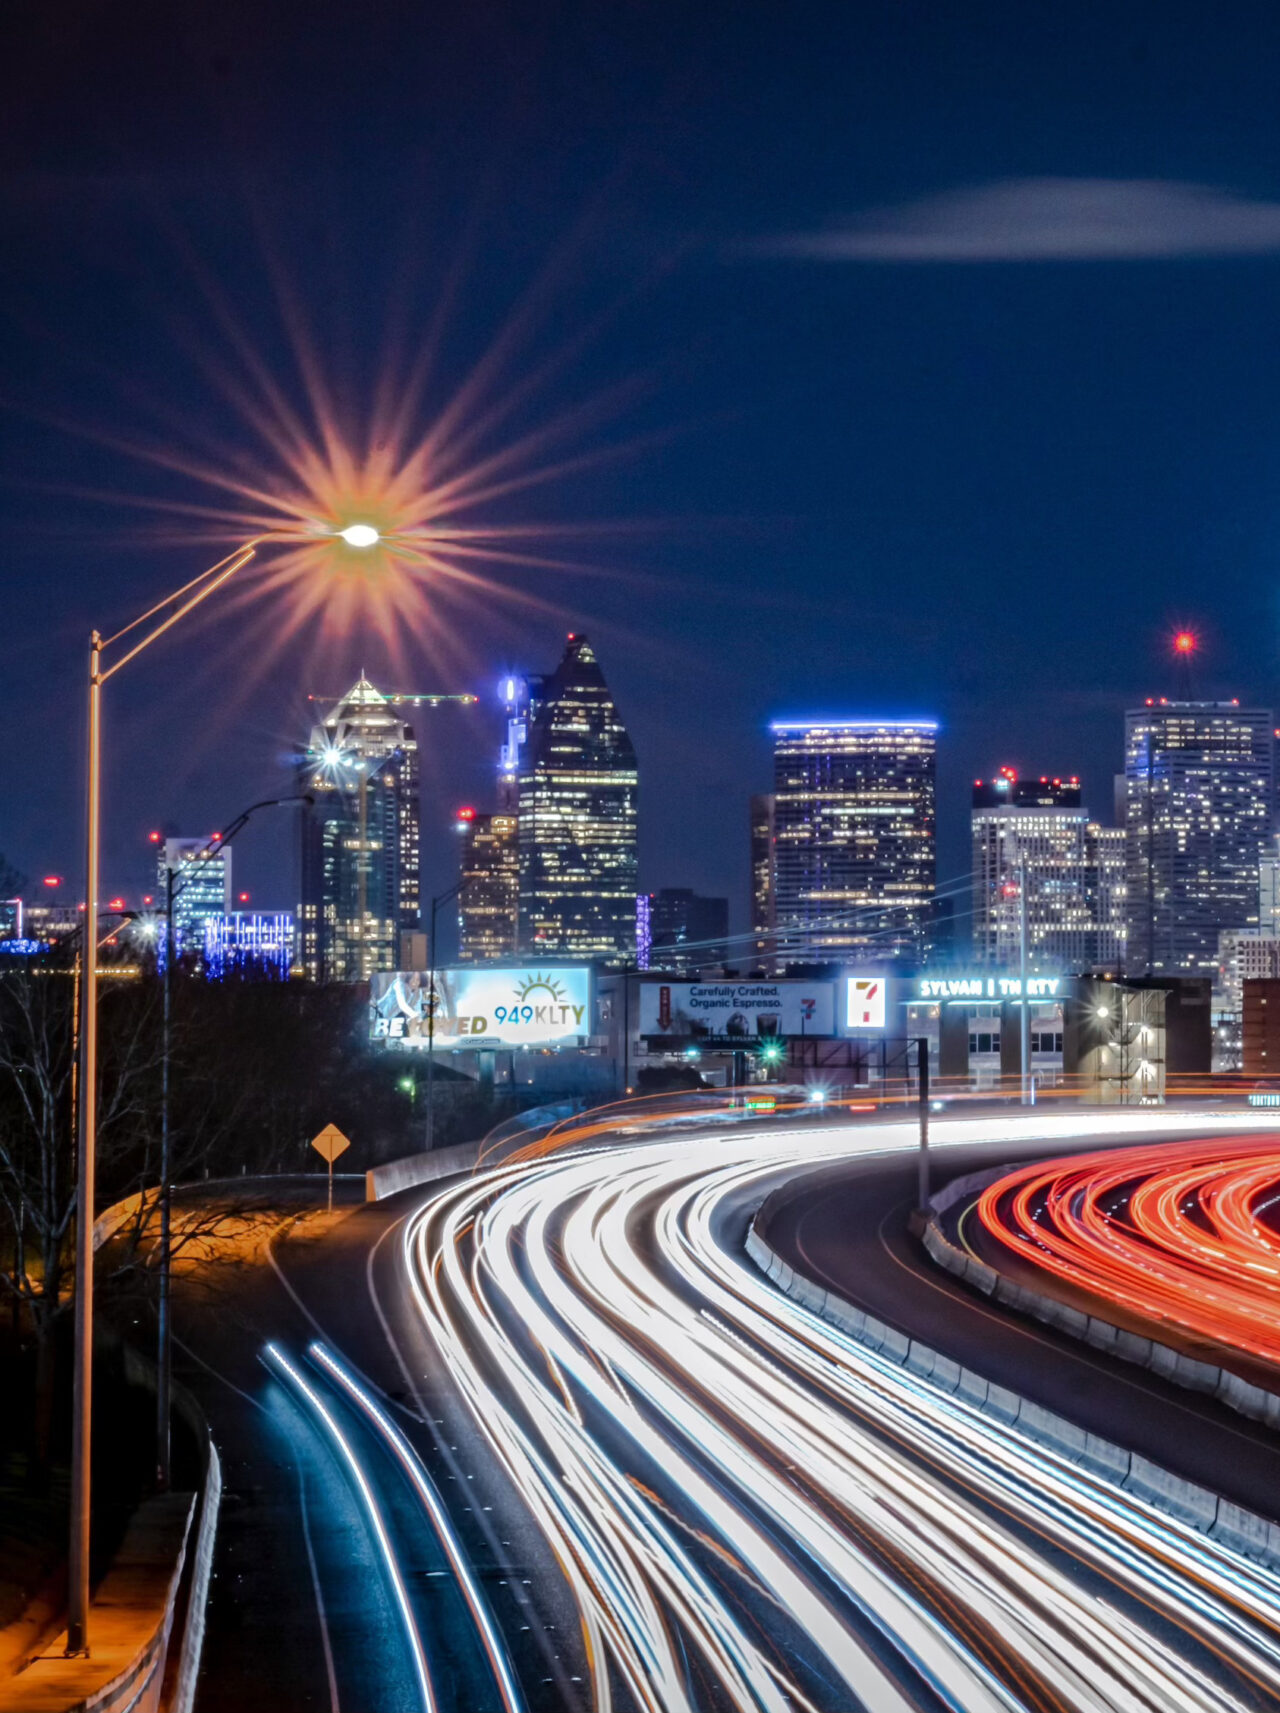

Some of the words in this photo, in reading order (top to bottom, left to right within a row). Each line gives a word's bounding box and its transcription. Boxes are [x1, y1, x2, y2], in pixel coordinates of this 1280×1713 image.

[689, 986, 736, 998] Carefully
[738, 986, 780, 997] Crafted.
[920, 980, 982, 996] SYLVAN
[999, 978, 1060, 996] THRTY
[689, 998, 730, 1010] Organic
[732, 999, 783, 1010] Espresso.
